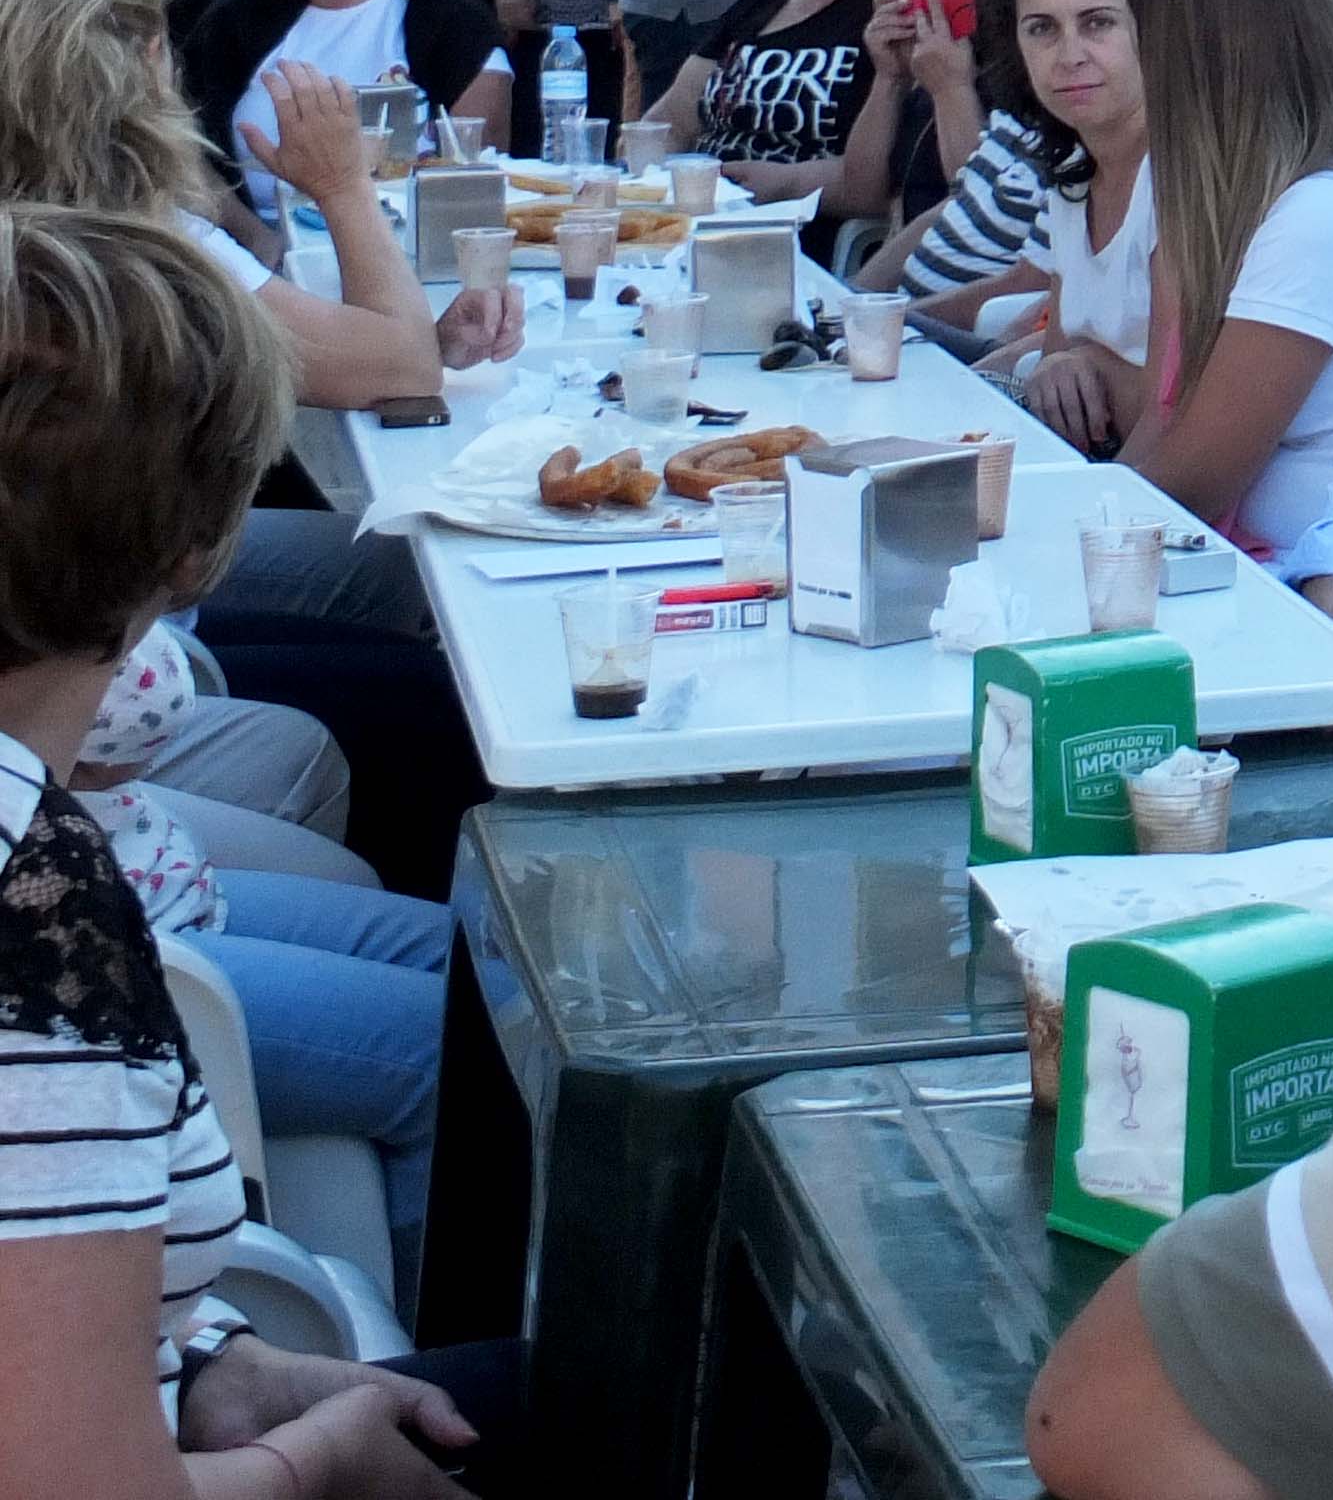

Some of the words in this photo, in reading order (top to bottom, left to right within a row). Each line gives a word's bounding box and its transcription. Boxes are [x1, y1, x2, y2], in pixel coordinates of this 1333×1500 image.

[1073, 736, 1144, 758] IMPORTADO
[1146, 734, 1164, 746] NO
[1245, 1054, 1318, 1089] IMPORTADO
